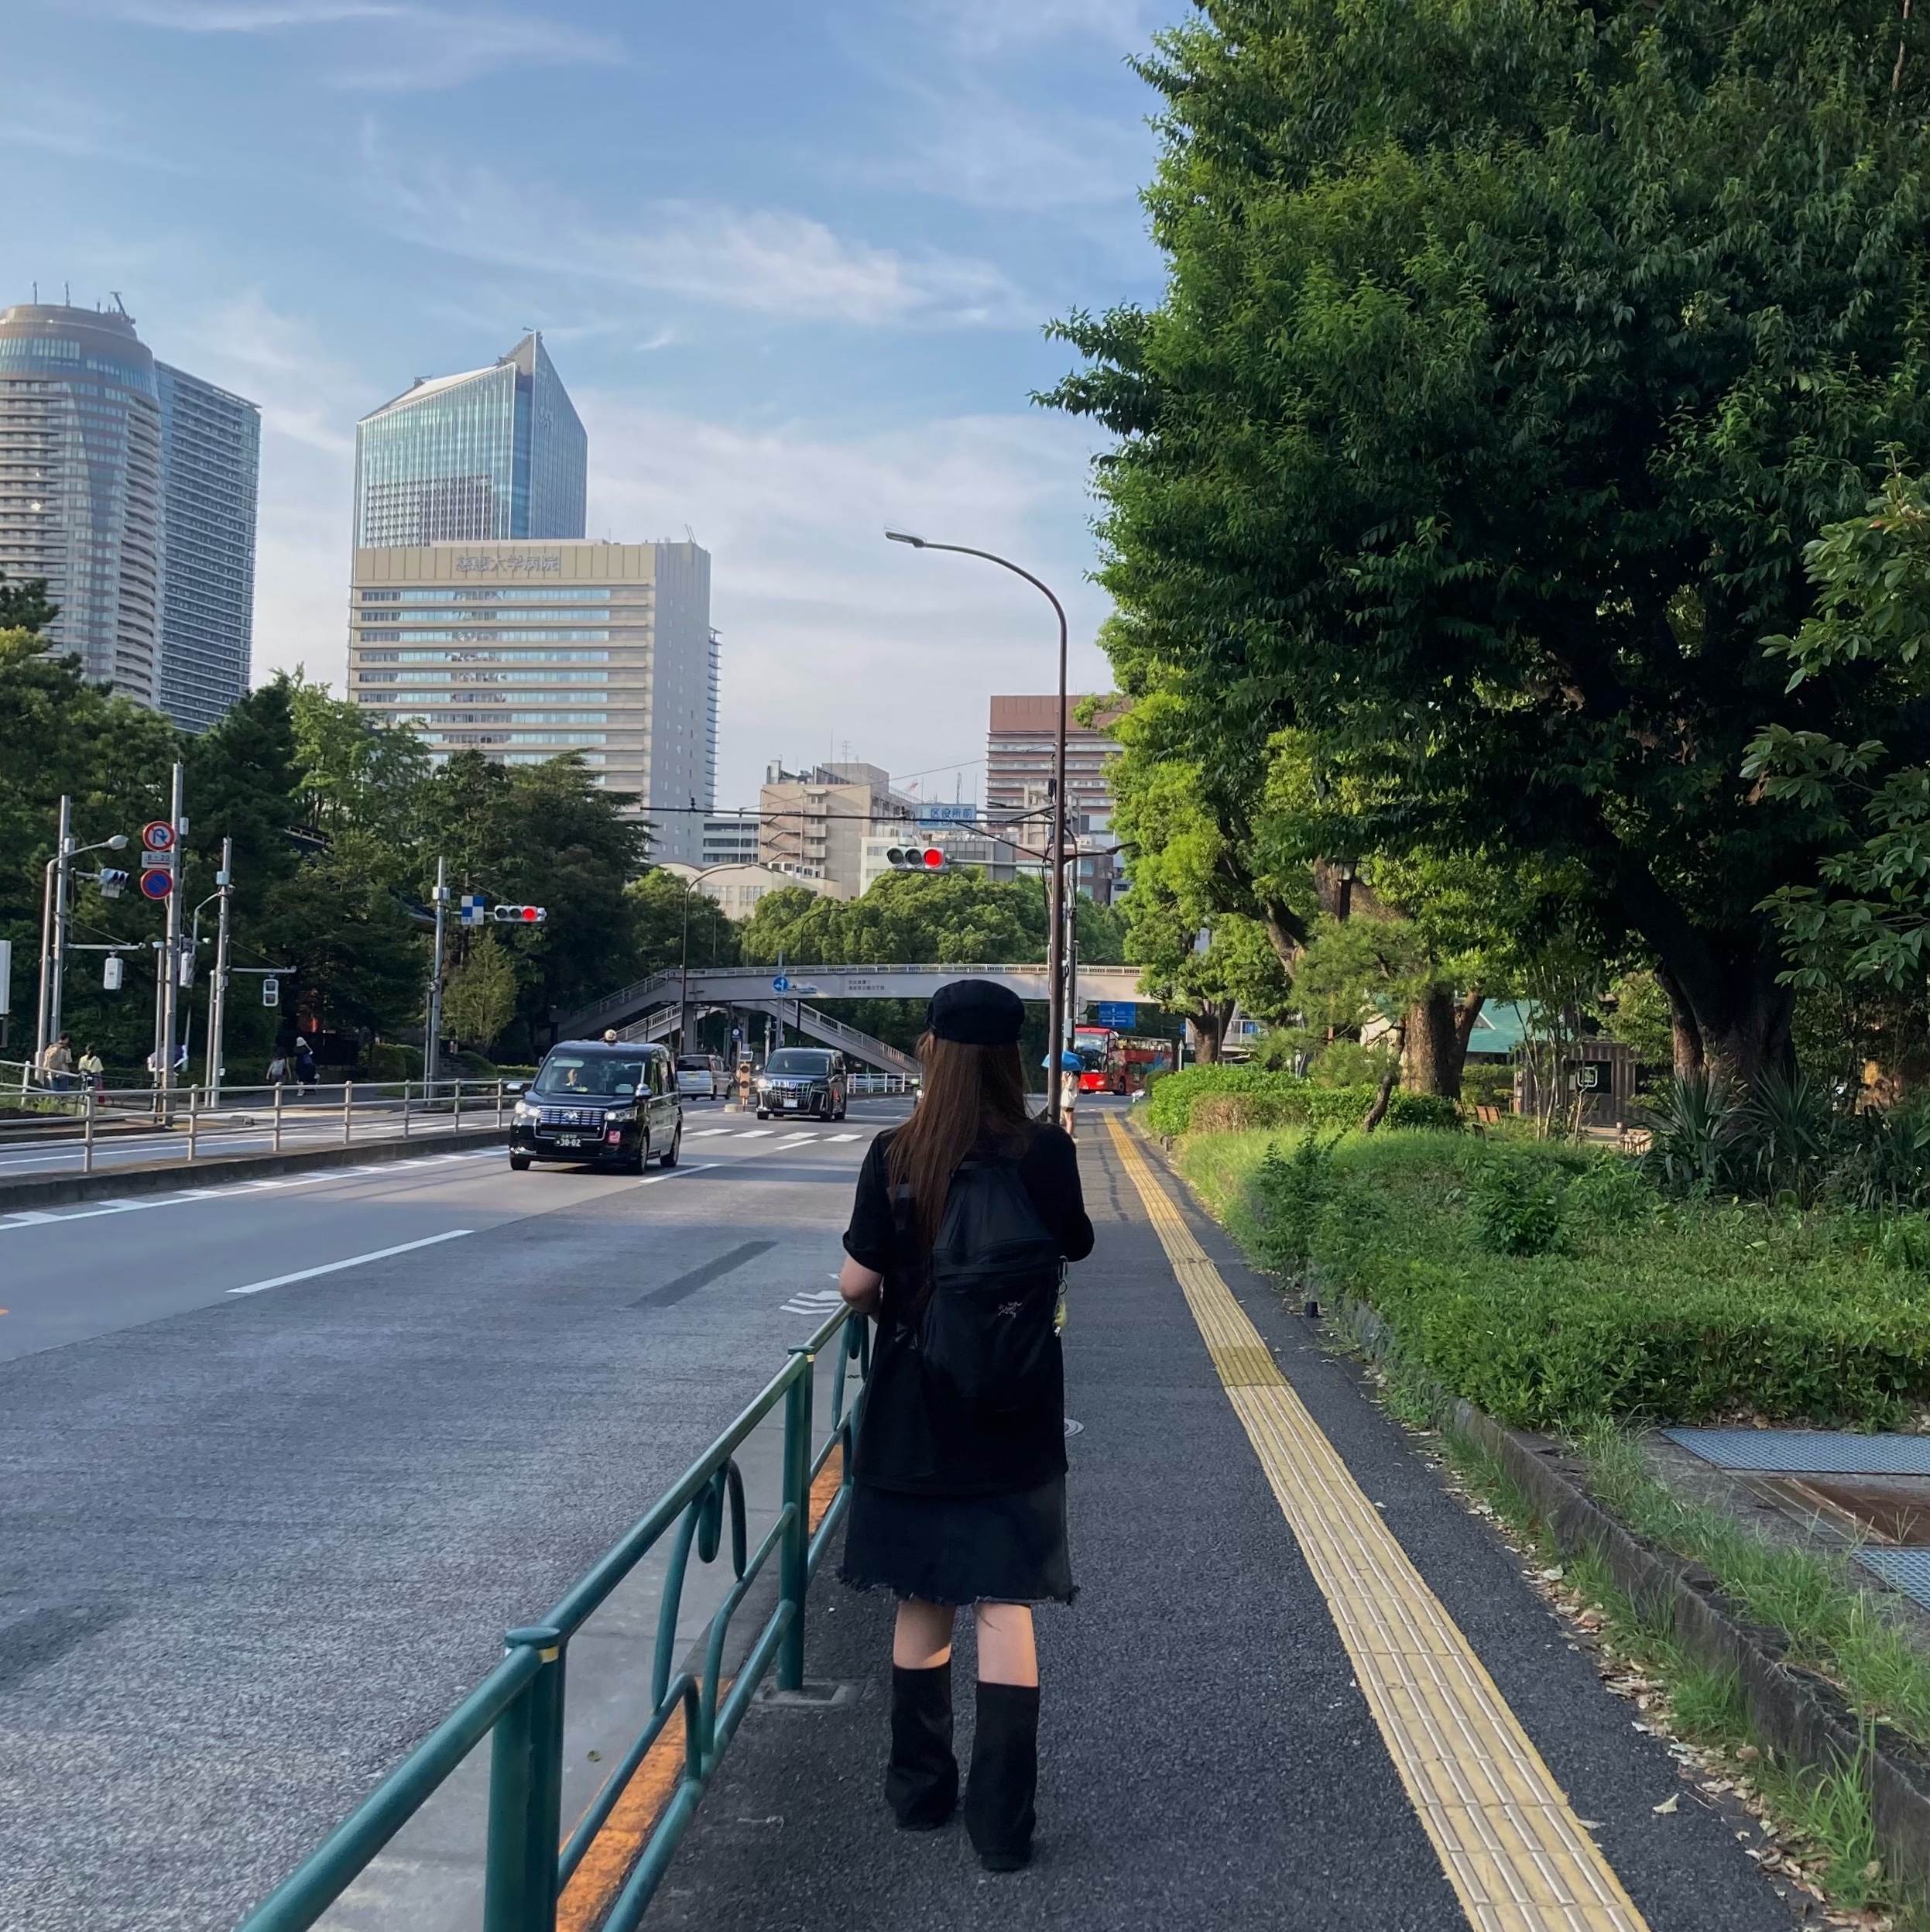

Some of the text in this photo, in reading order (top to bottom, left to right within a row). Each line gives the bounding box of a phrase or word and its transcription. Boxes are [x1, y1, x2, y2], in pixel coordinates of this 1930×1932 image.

[921, 808, 972, 819] 区役所前
[560, 1138, 581, 1147] 30-02
